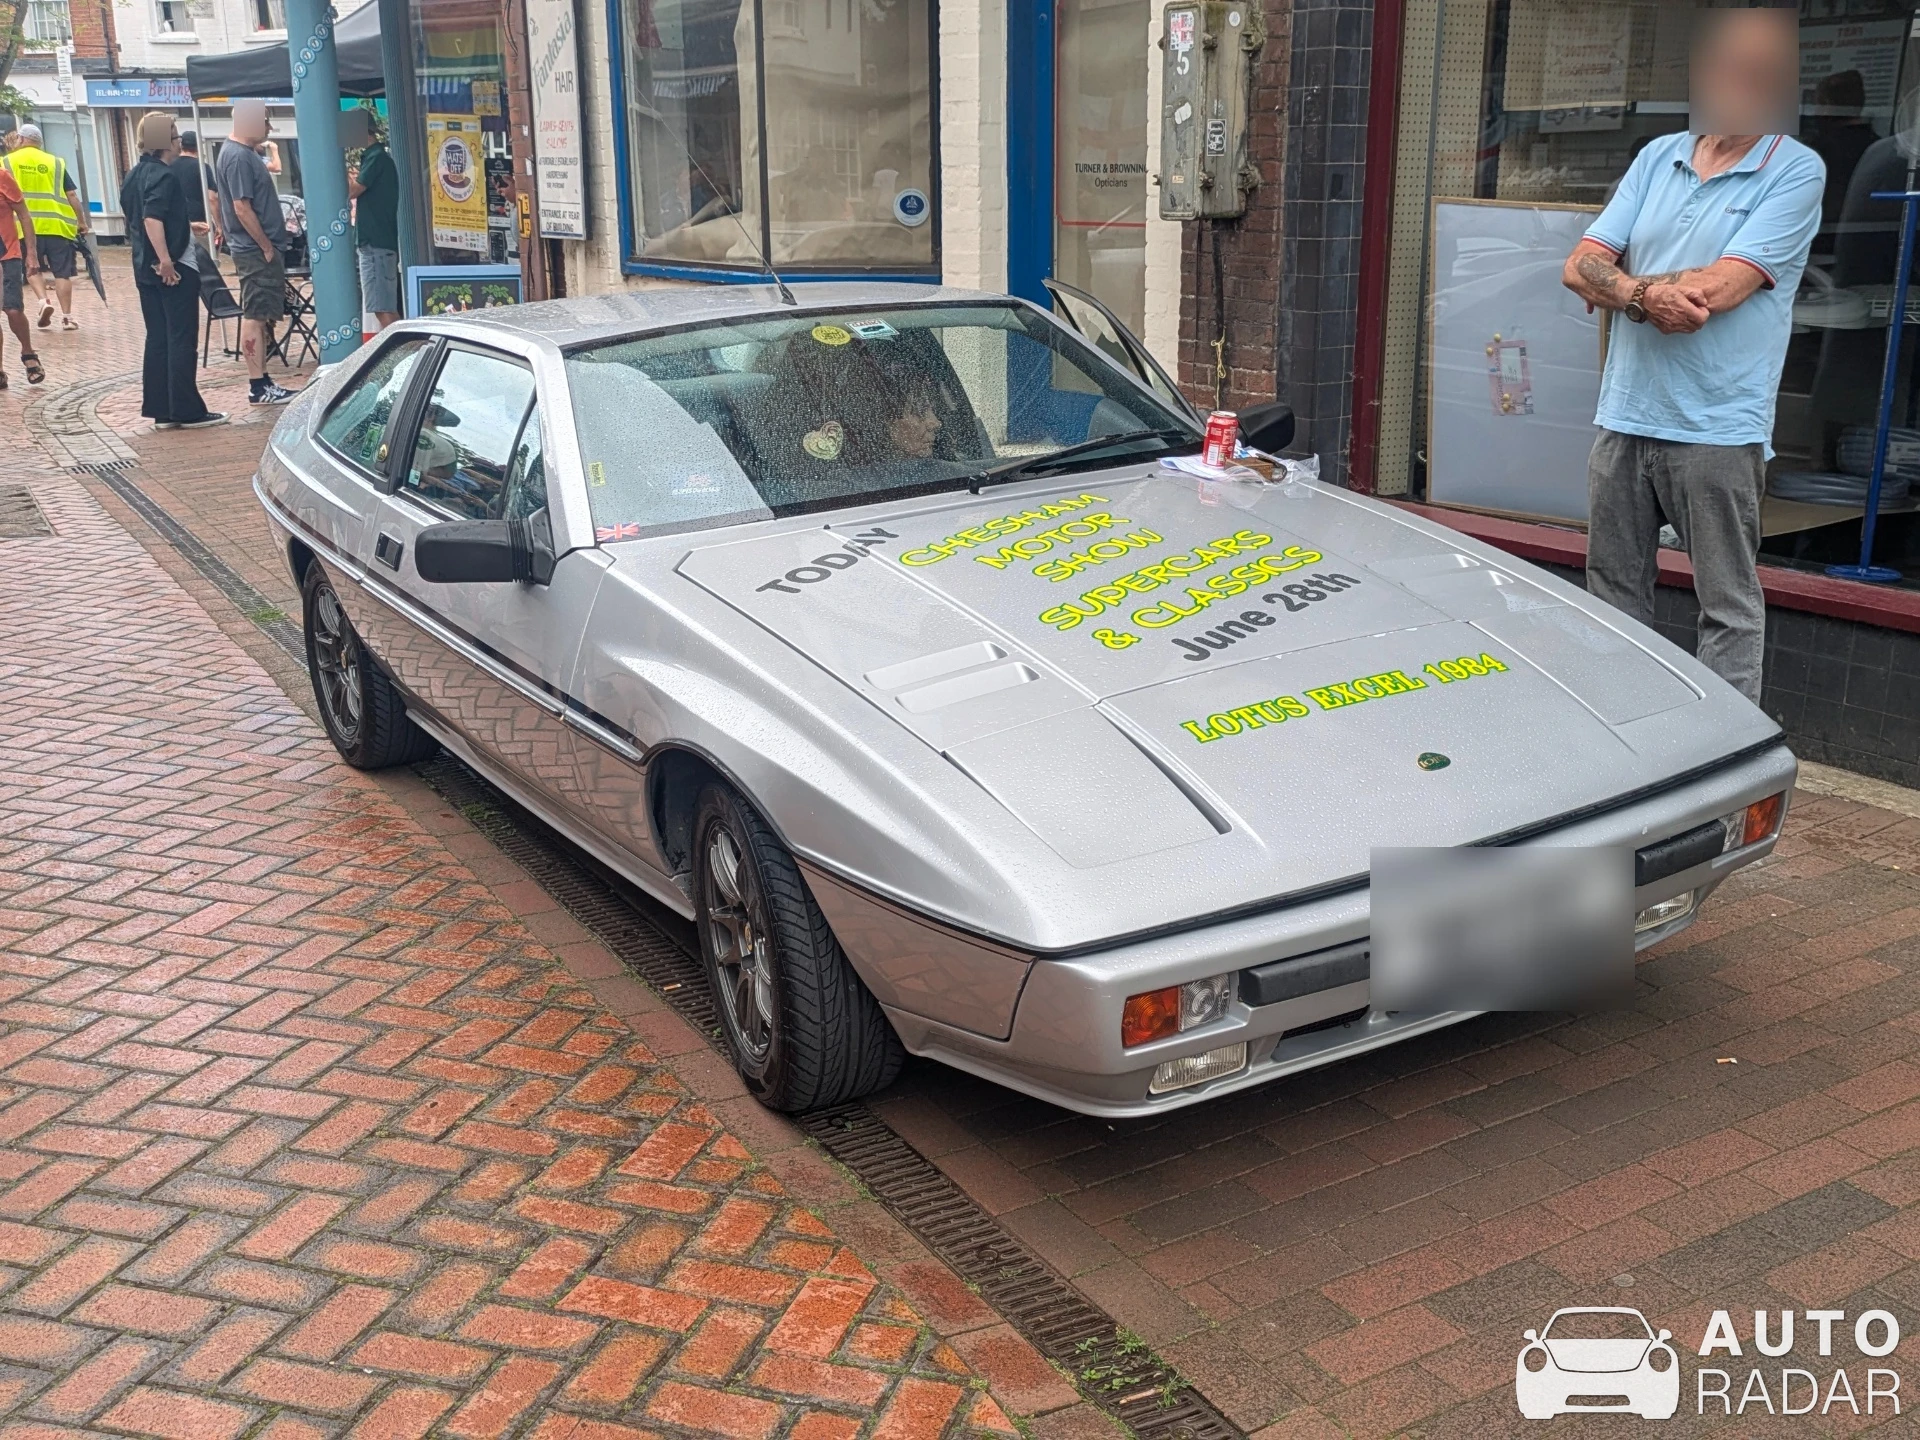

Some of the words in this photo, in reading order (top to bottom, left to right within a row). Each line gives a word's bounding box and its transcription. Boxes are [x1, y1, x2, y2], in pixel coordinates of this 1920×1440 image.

[148, 80, 191, 100] Beijing
[555, 71, 574, 93] HAIR
[446, 152, 463, 163] HATS
[451, 164, 462, 173] OFF
[1075, 163, 1101, 173] TURNER
[1102, 163, 1108, 173] &
[1094, 177, 1128, 188] Opticians
[541, 209, 562, 219] ENTRANCE
[562, 210, 568, 219] AT
[568, 211, 580, 220] REAR
[546, 222, 552, 231] OF
[553, 222, 574, 232] BUILDING
[899, 493, 1111, 568] CHESHAM
[973, 512, 1132, 570] MOTOR
[755, 527, 900, 594] TODAY
[1032, 527, 1164, 583] SHOW
[1038, 529, 1273, 631] SUPERCARS
[1091, 628, 1142, 650] &
[1130, 545, 1323, 629] CLASSICS
[1171, 609, 1277, 662] June
[1261, 572, 1361, 612] 28th
[1179, 695, 1311, 744] LOTUS
[1302, 669, 1430, 711] EXCEL
[1421, 652, 1511, 684] 1984
